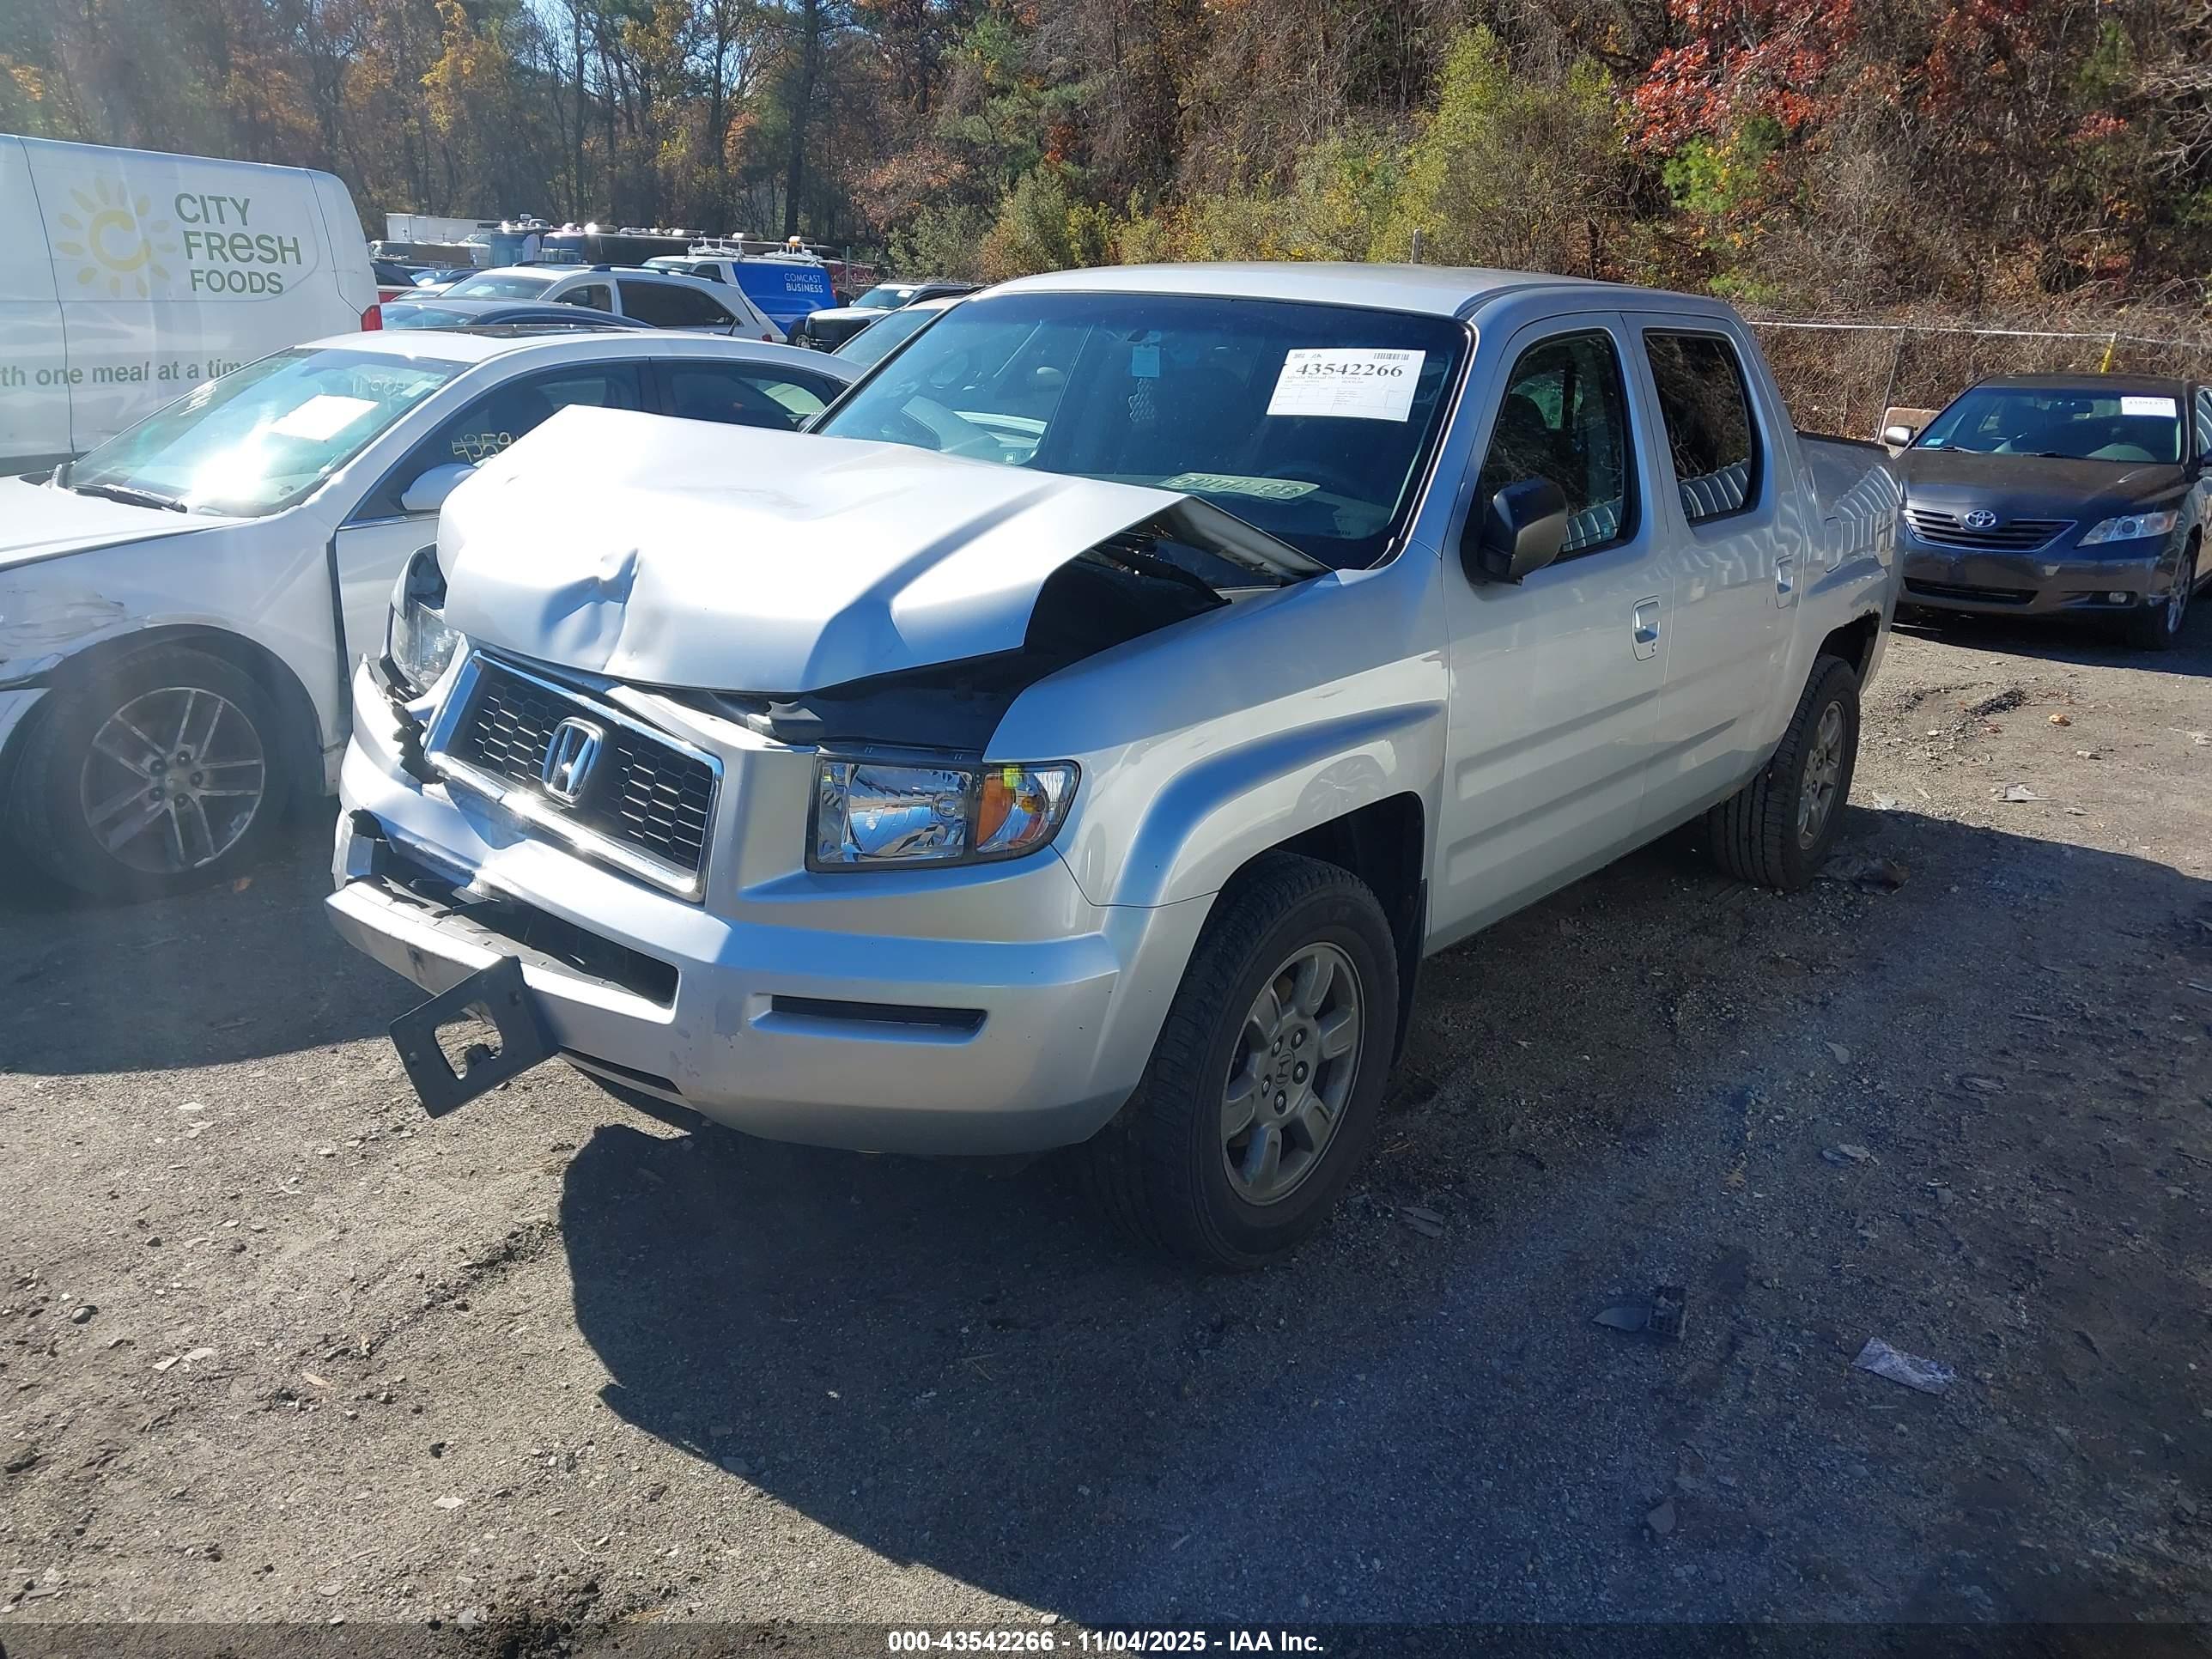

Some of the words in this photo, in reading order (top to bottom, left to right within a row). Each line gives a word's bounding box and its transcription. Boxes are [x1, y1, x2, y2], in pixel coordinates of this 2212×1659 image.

[174, 192, 251, 226] CITY
[190, 269, 284, 295] FOODS
[784, 272, 822, 284] COMCAST
[786, 283, 823, 294] BUSINESS
[35, 367, 83, 386] one
[92, 362, 150, 384] meal
[158, 362, 179, 380] at
[186, 363, 200, 380] a
[1295, 362, 1405, 378] 43542266
[451, 432, 520, 463] 4359
